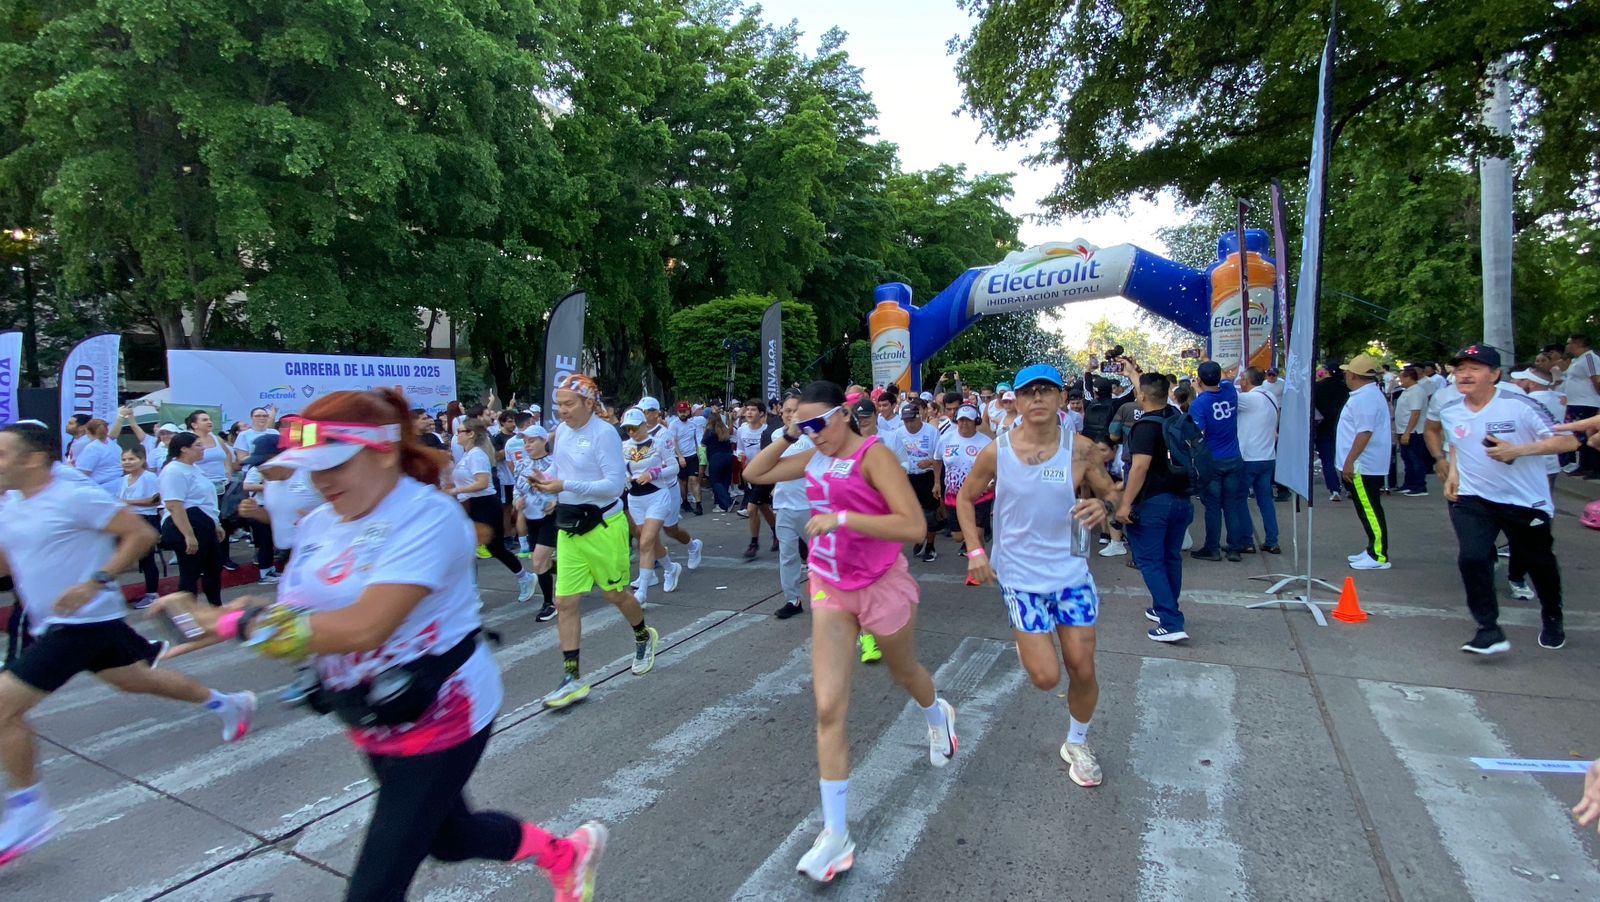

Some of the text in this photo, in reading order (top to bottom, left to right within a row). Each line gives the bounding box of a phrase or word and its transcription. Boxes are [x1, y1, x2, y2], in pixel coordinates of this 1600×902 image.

[987, 260, 1102, 294] Electrolit
[1061, 285, 1100, 297] TOTAL!
[1213, 314, 1270, 328] Elecolit
[285, 362, 440, 378] CARRERA DE LA SALUD 2025
[767, 339, 777, 400] SINALOA
[74, 364, 95, 416] LUD
[259, 391, 296, 399] Electrolit
[1043, 469, 1064, 478] 0278
